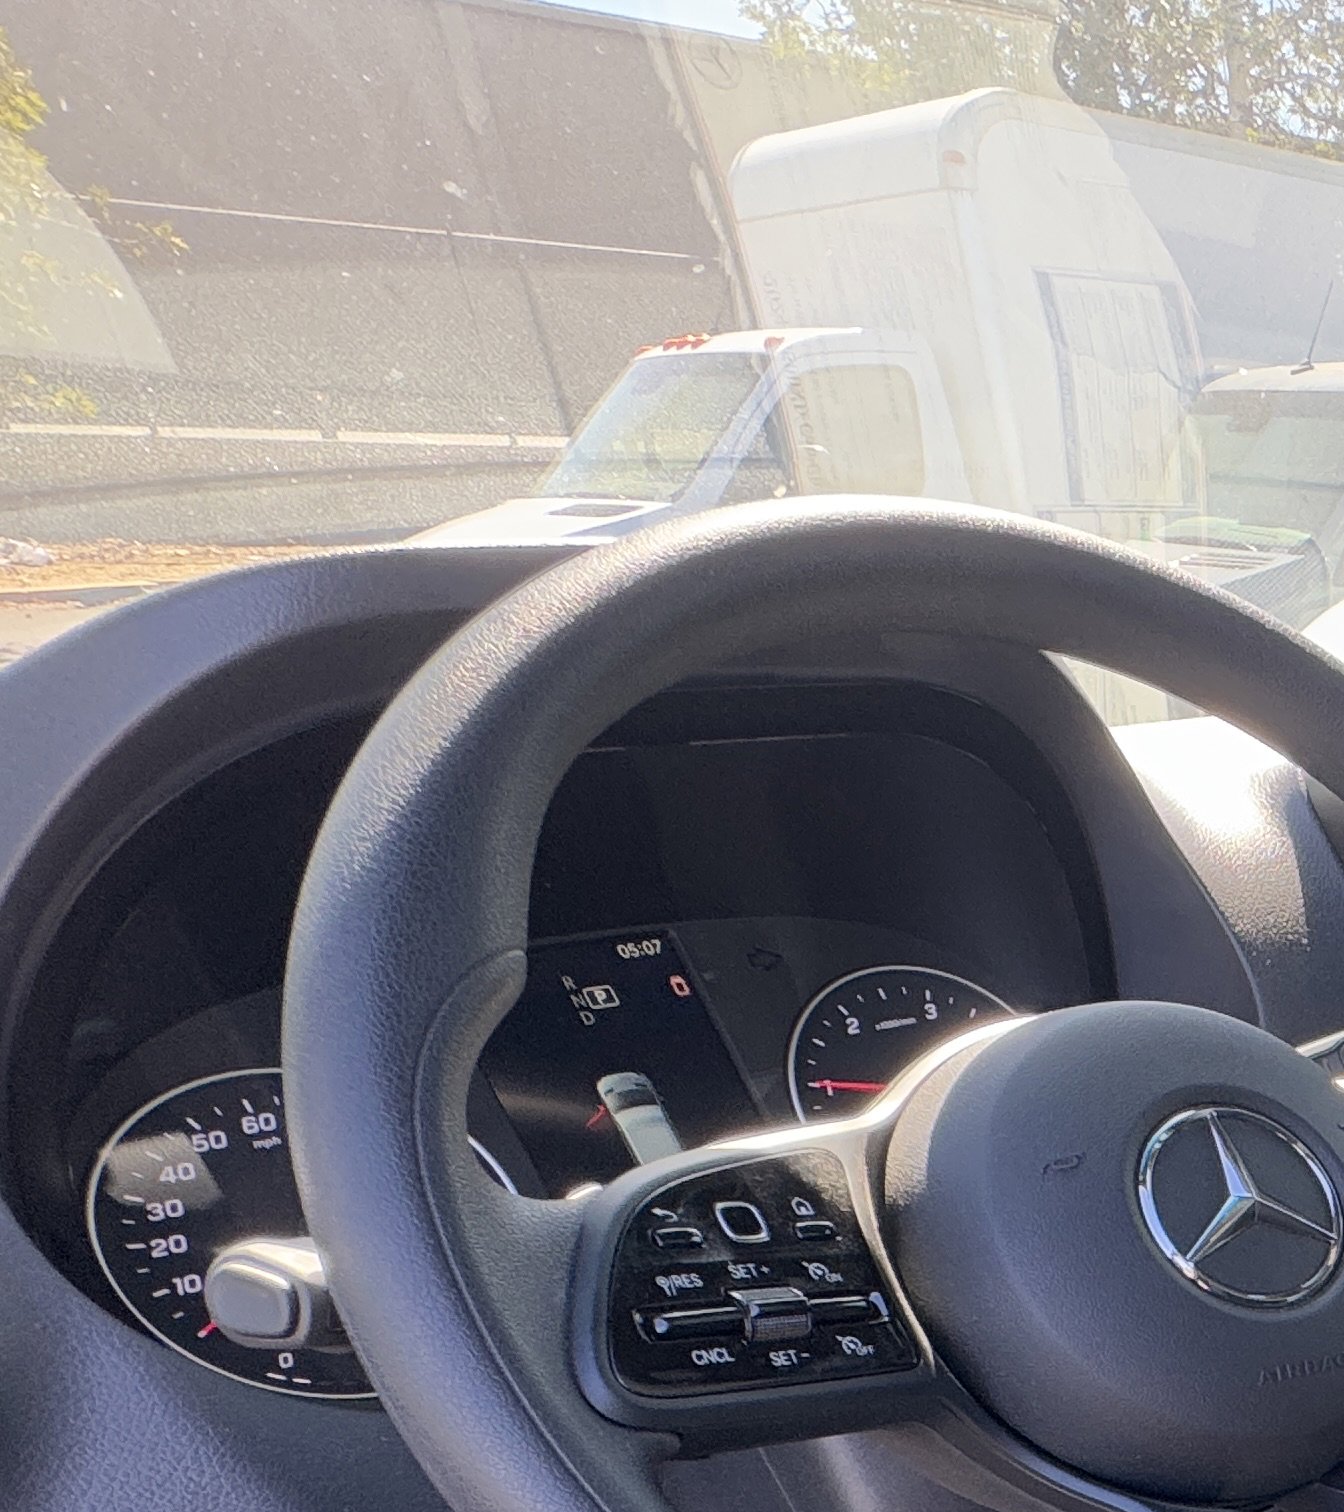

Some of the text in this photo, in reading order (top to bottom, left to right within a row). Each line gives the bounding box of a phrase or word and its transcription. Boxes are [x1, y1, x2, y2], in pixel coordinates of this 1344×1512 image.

[616, 939, 661, 959] 05:07
[594, 989, 608, 1006] P
[580, 1010, 596, 1026] D
[924, 1003, 938, 1020] 3
[845, 1017, 860, 1035] 2
[241, 1112, 278, 1135] 60
[191, 1130, 229, 1152] 50
[252, 1136, 282, 1150] mph
[159, 1162, 196, 1184] 40
[145, 1199, 186, 1222] 30
[149, 1234, 189, 1258] 20
[171, 1273, 202, 1296] 10
[278, 1352, 294, 1369] 0
[691, 1347, 735, 1366] CNCL
